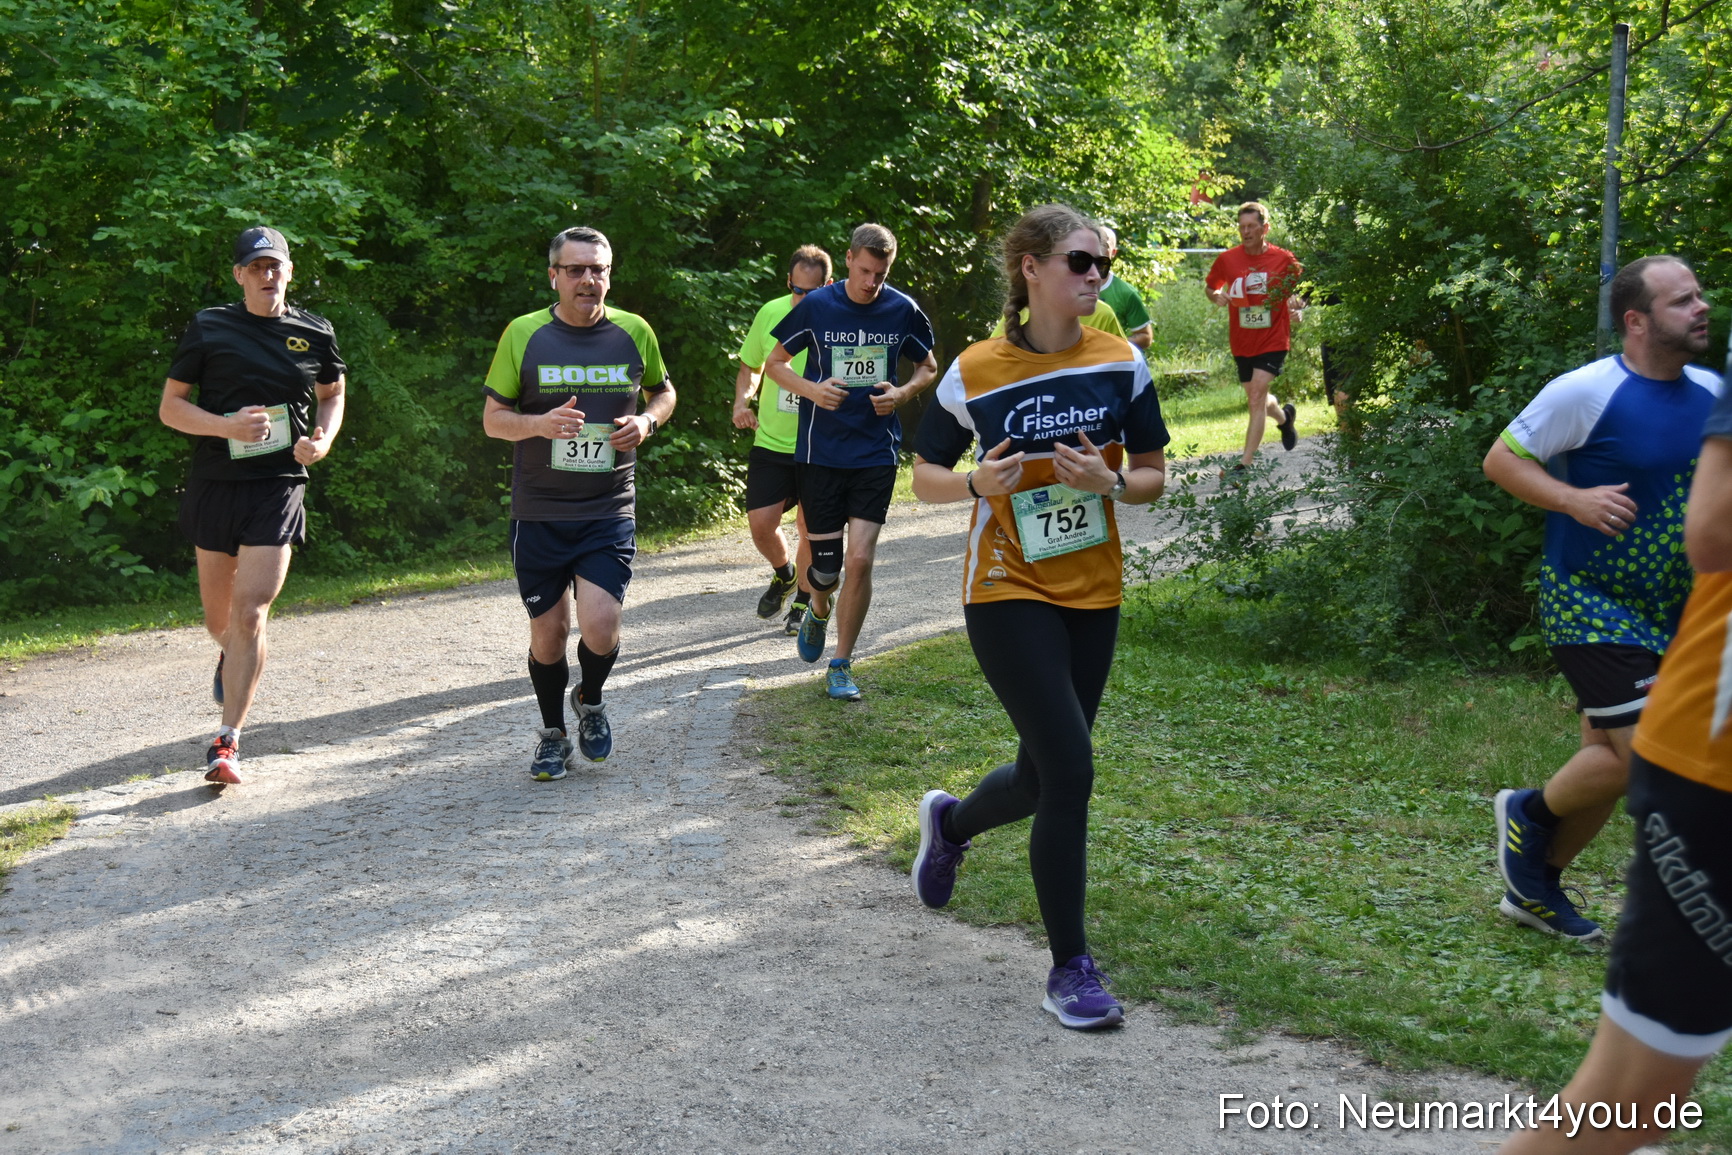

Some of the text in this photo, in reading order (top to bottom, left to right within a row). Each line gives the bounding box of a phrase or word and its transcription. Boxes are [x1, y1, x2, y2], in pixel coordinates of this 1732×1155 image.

[1246, 314, 1263, 322] 554
[824, 331, 899, 344] EURO POLES
[539, 366, 630, 384] BOCK
[844, 360, 875, 376] 708
[539, 386, 568, 394] inspired
[570, 386, 579, 394] by
[1023, 406, 1108, 432] Fischer
[1033, 423, 1102, 441] AUTOMOBILE
[566, 440, 604, 458] 317
[1036, 504, 1088, 538] 752
[1047, 530, 1086, 544] Graf Andrea
[1057, 538, 1082, 548] Automobile
